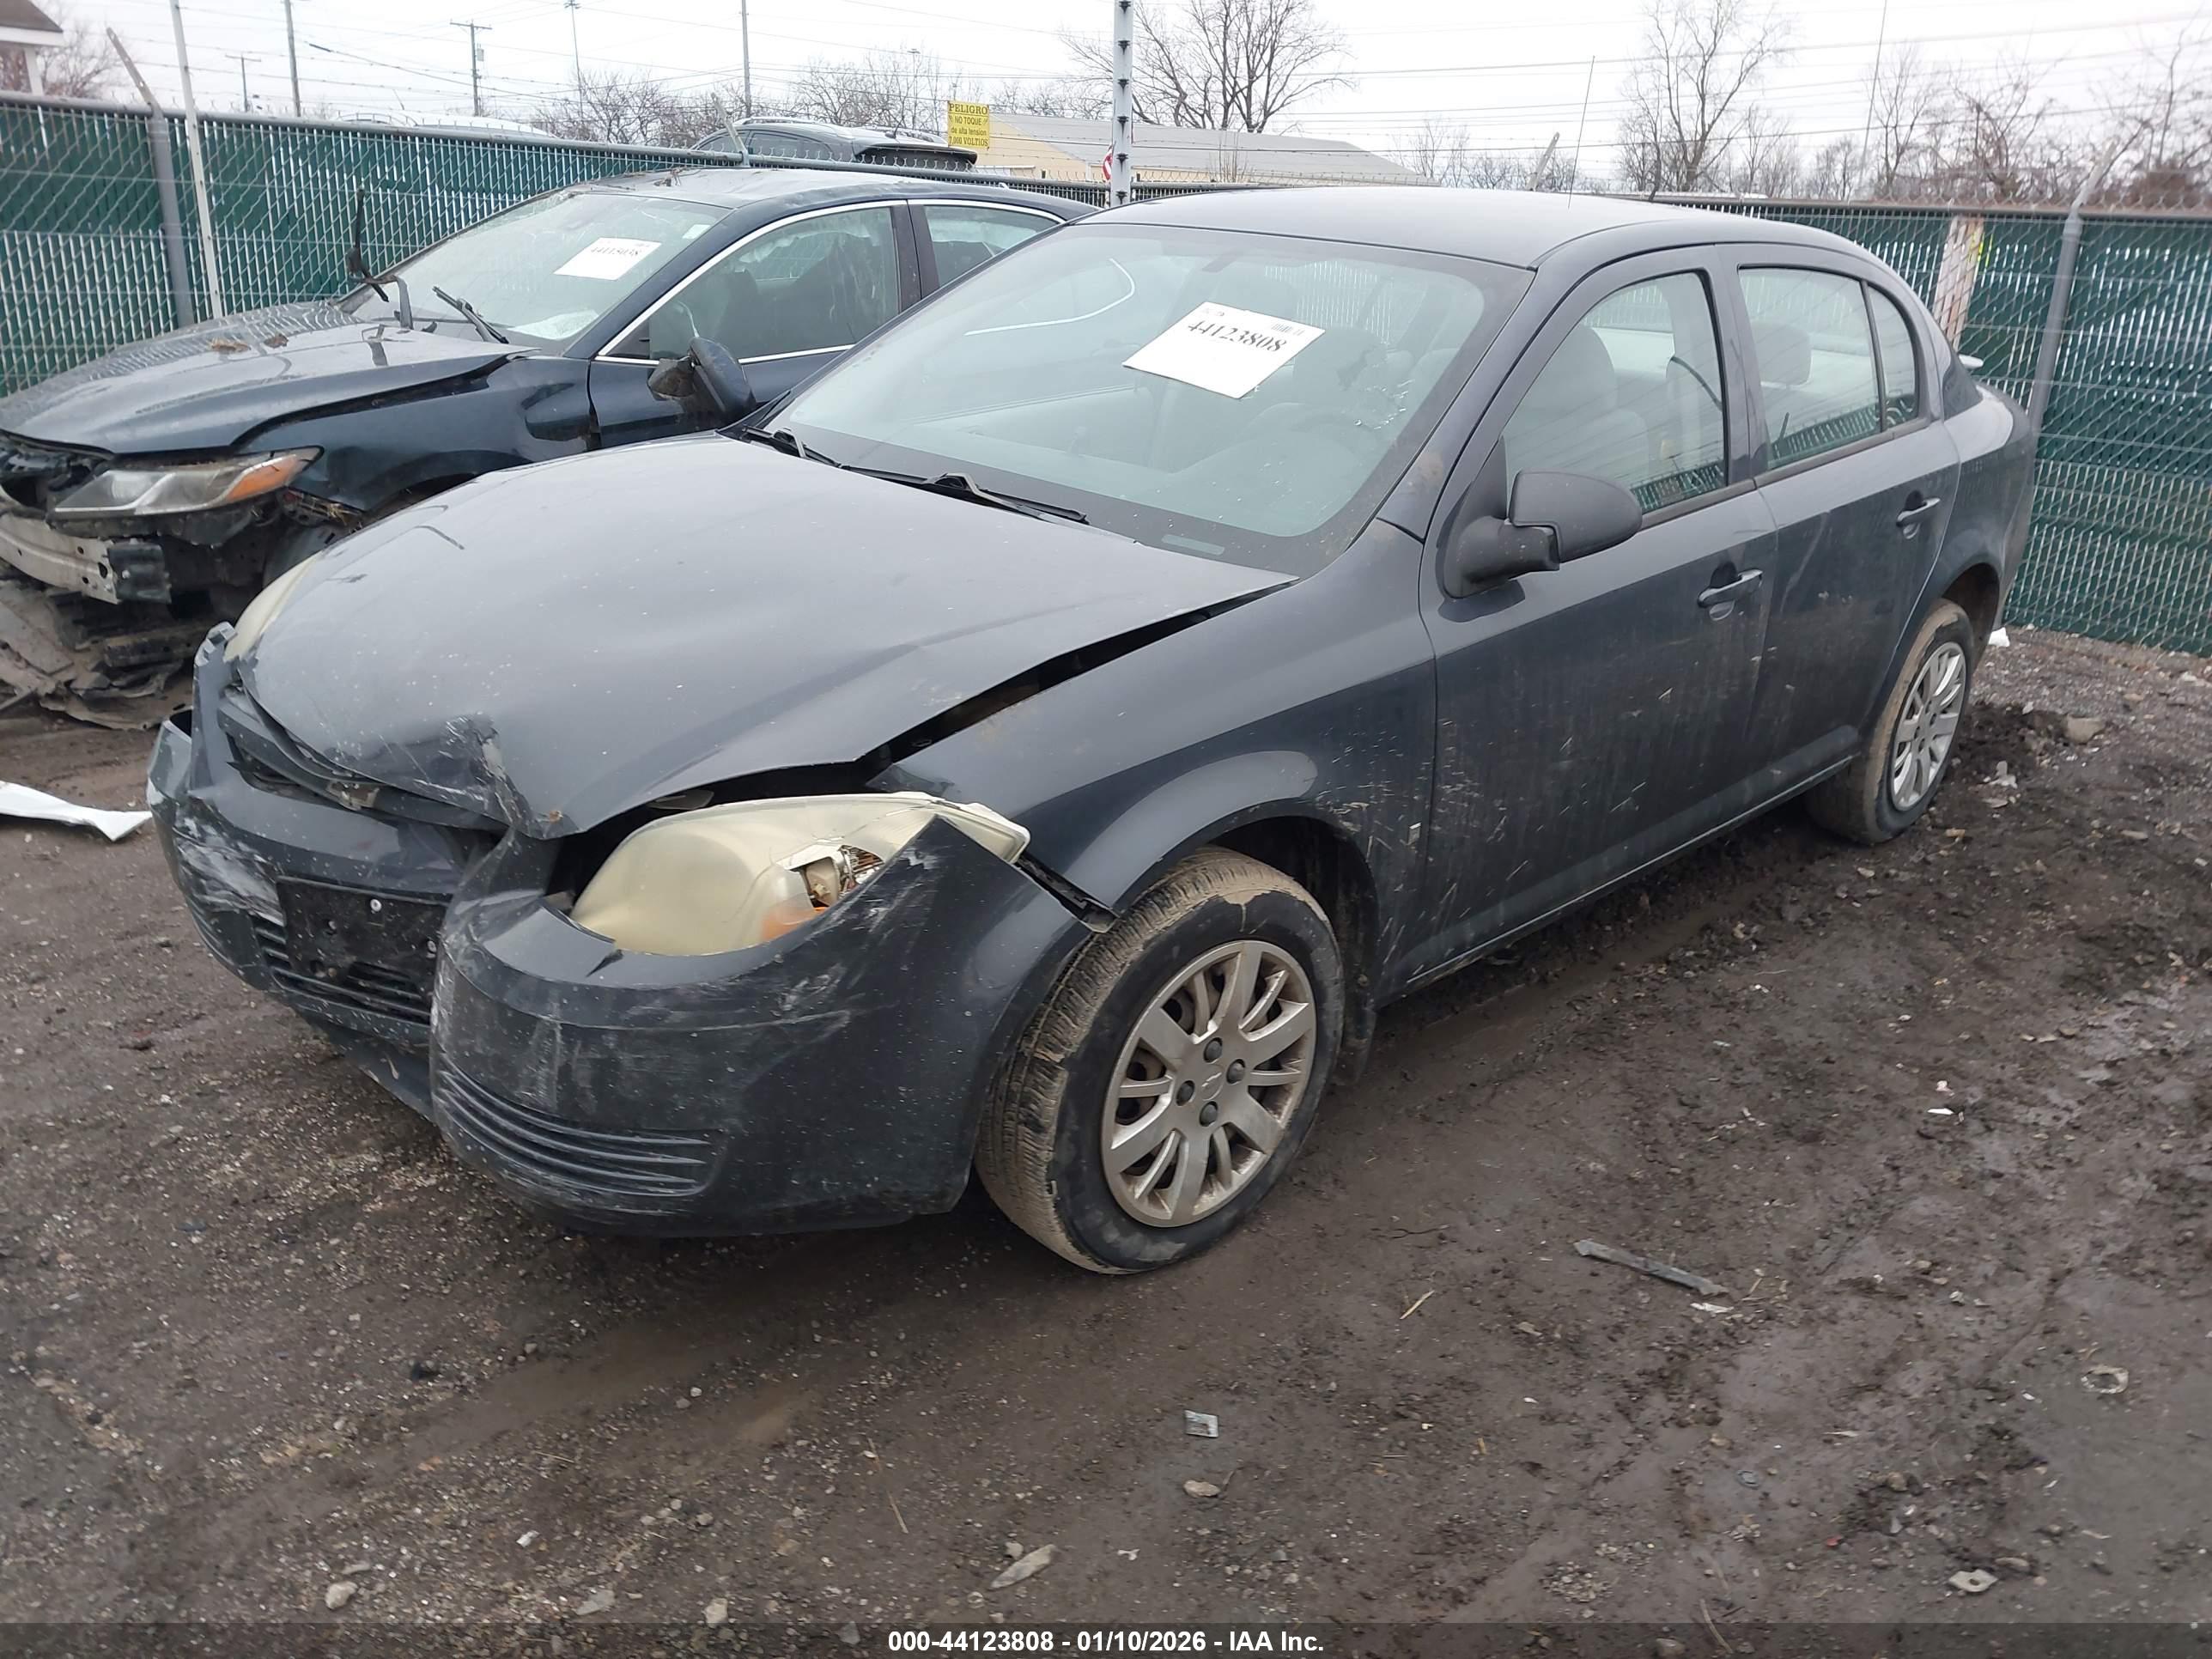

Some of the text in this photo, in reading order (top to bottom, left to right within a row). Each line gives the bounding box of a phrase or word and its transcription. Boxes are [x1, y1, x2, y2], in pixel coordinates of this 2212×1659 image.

[949, 103, 988, 115] PELIGRO
[955, 115, 981, 125] NO TOQUE
[958, 126, 968, 135] alta
[963, 137, 988, 147] VOLTIOS
[1188, 320, 1287, 352] 44123808
